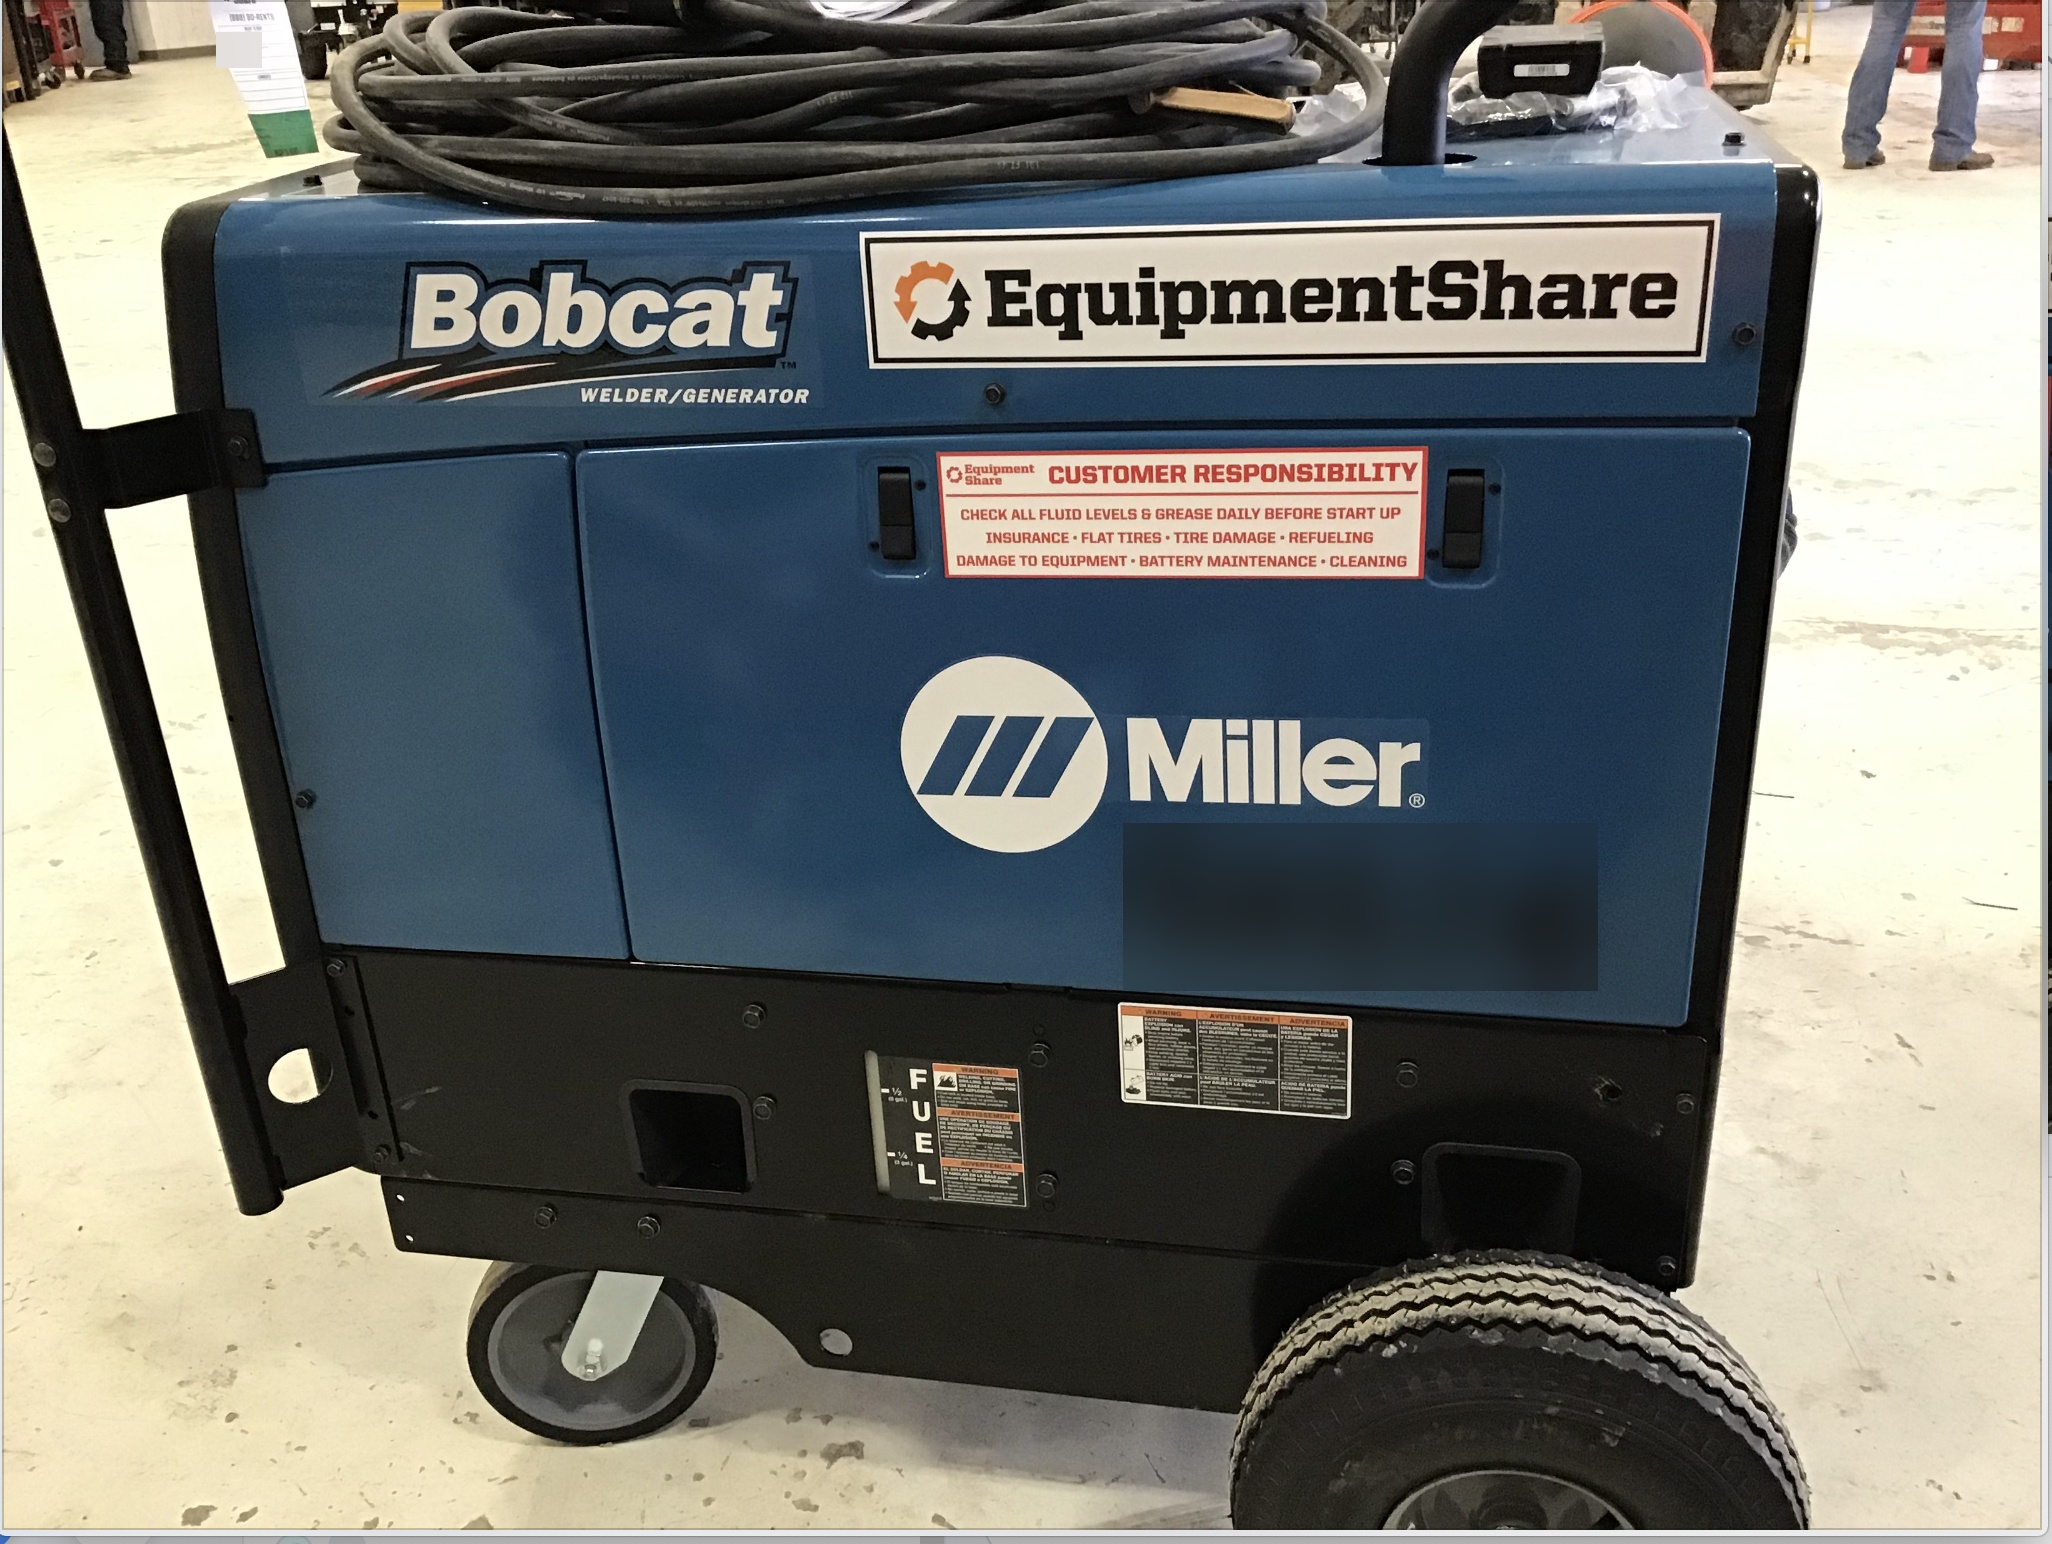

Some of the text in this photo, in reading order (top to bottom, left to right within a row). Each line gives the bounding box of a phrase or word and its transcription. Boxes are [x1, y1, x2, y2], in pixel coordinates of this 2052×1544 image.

[985, 259, 1678, 341] EquipmentShare
[411, 272, 784, 349] Bobcat
[580, 387, 810, 404] WELDER/GENERATOR
[965, 464, 1035, 476] Equipment
[1048, 461, 1418, 484] CUSTOMER RESPONSIBILITY
[965, 476, 1002, 485] Share
[961, 507, 1401, 521] CHECK ALL FLUID LEVELS & GREASE DAILY BEFORE START UP
[986, 531, 1374, 544] INSURANCE FLAT TIRES TIRE DAMAGE REFUELING
[957, 555, 1407, 567] DAMAGE TO EQUIPMENT BATTERY MAINTENANCE CLEANING
[1127, 718, 1421, 807] Miller
[1210, 1014, 1274, 1022] AVERTISSEMENT
[1290, 1018, 1345, 1027] ADVERTENCIA
[961, 1067, 999, 1075] WARNING
[951, 1110, 1015, 1119] AVERTISSEMENT
[909, 1068, 937, 1185] FUEL
[960, 1161, 1012, 1169] ADVERTENCIA
